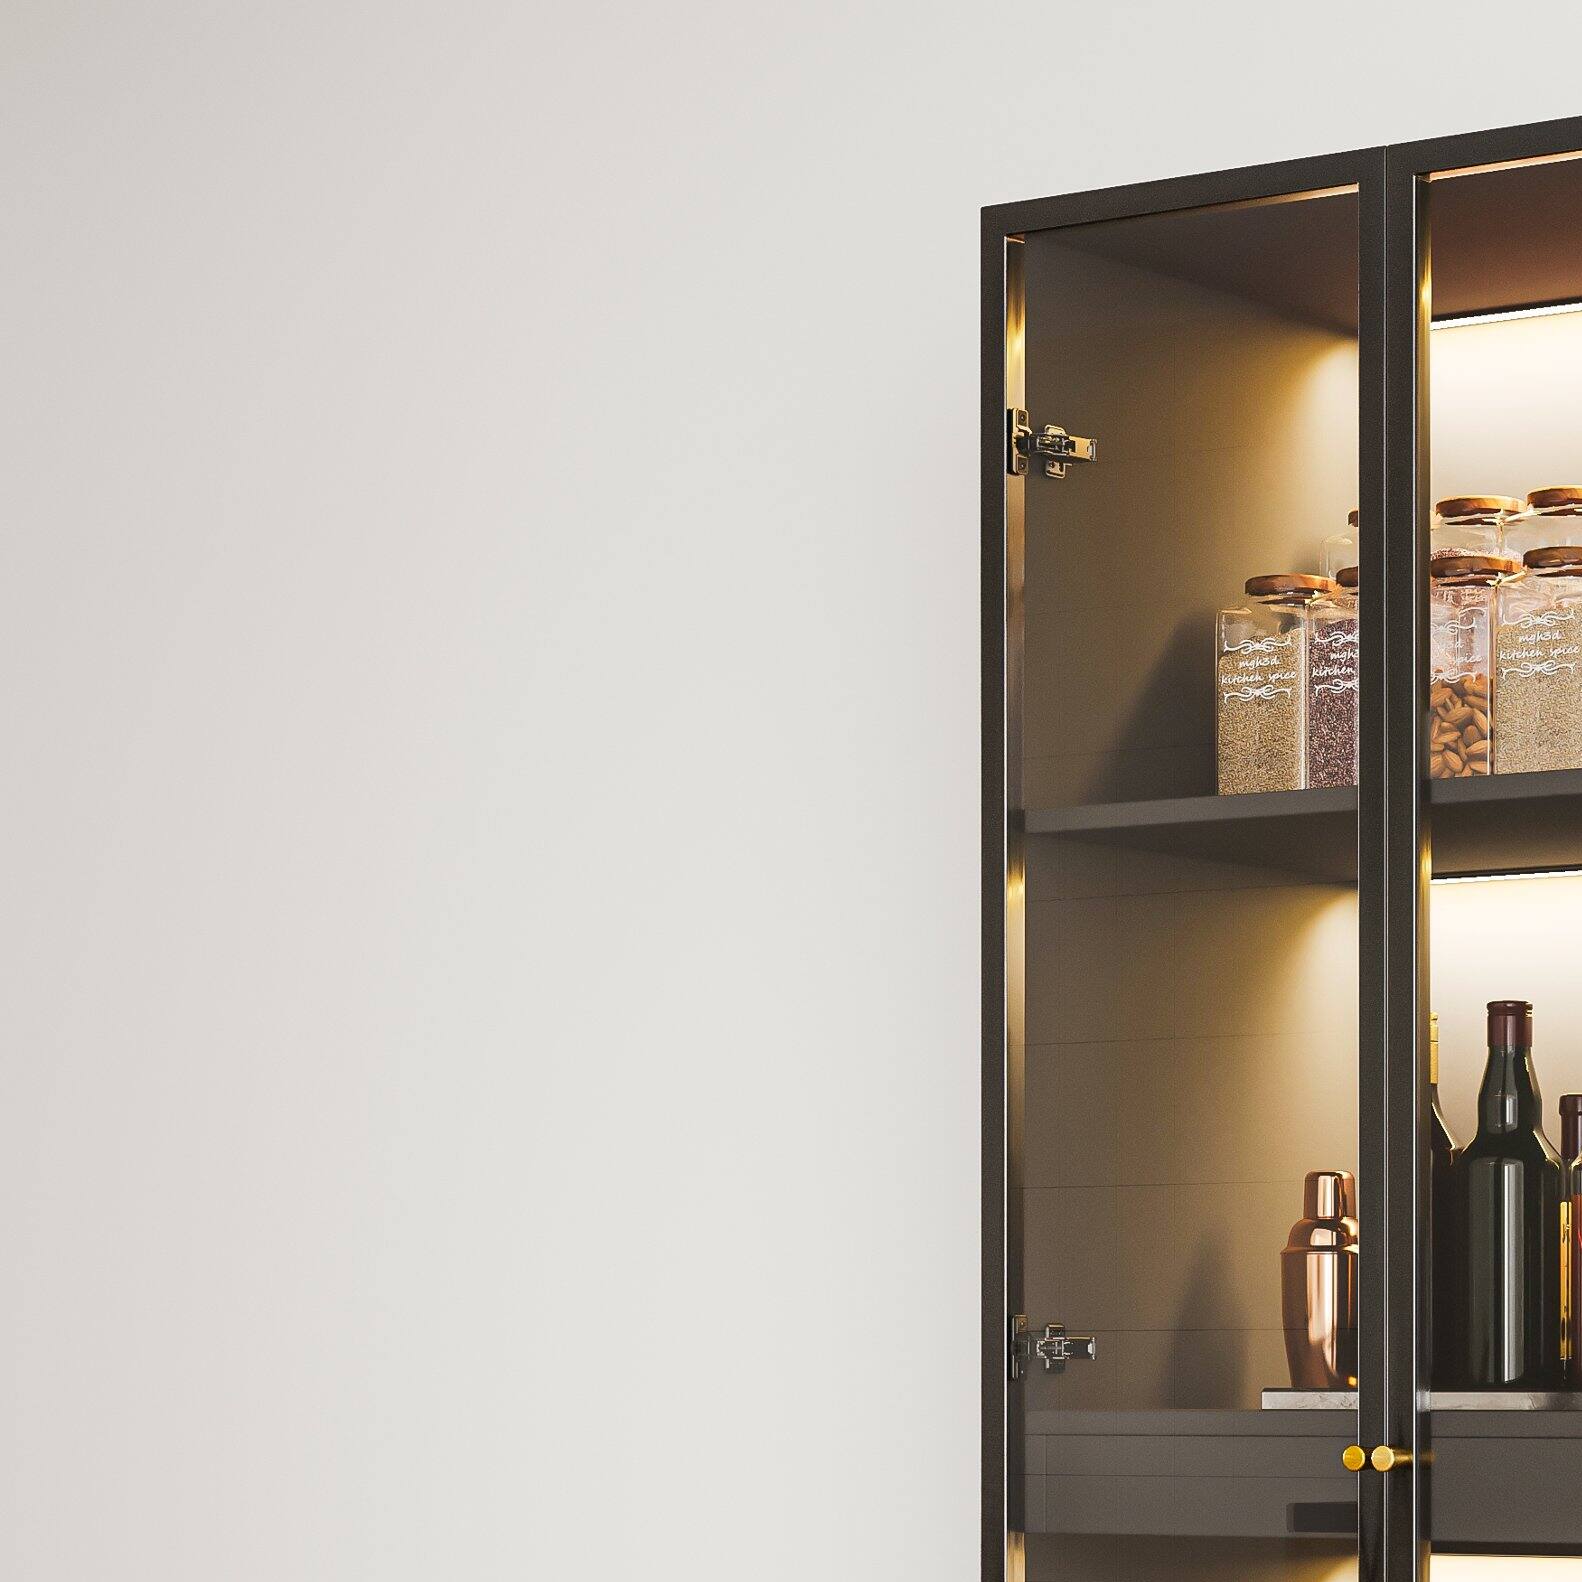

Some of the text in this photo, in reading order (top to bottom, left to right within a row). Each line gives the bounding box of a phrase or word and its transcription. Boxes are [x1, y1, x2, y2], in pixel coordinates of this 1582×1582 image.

[1500, 644, 1579, 661] kitchen spice
[1221, 670, 1297, 684] kitchen spice
[1312, 665, 1356, 678] kitchen
